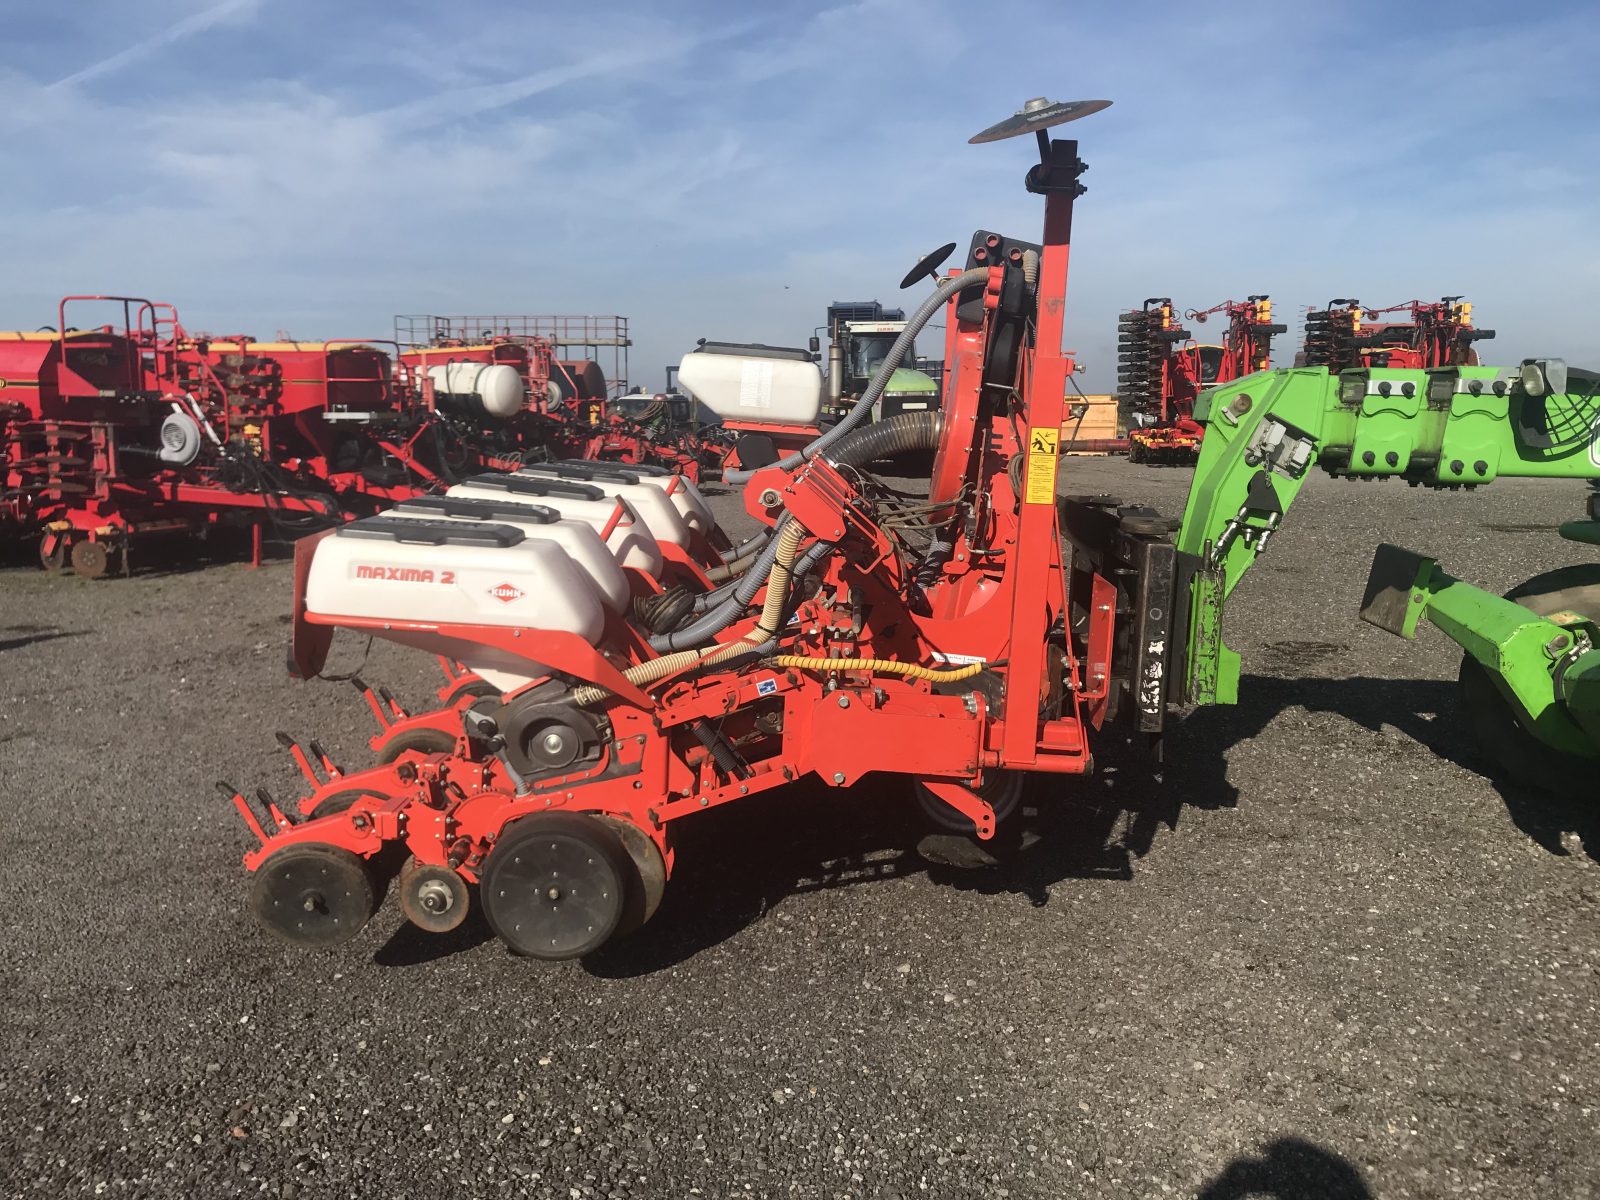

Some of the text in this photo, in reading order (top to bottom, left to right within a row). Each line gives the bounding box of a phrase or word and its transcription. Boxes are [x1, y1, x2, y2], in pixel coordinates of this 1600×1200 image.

[356, 565, 455, 584] MAXIMA 2
[491, 588, 521, 598] KUHN
